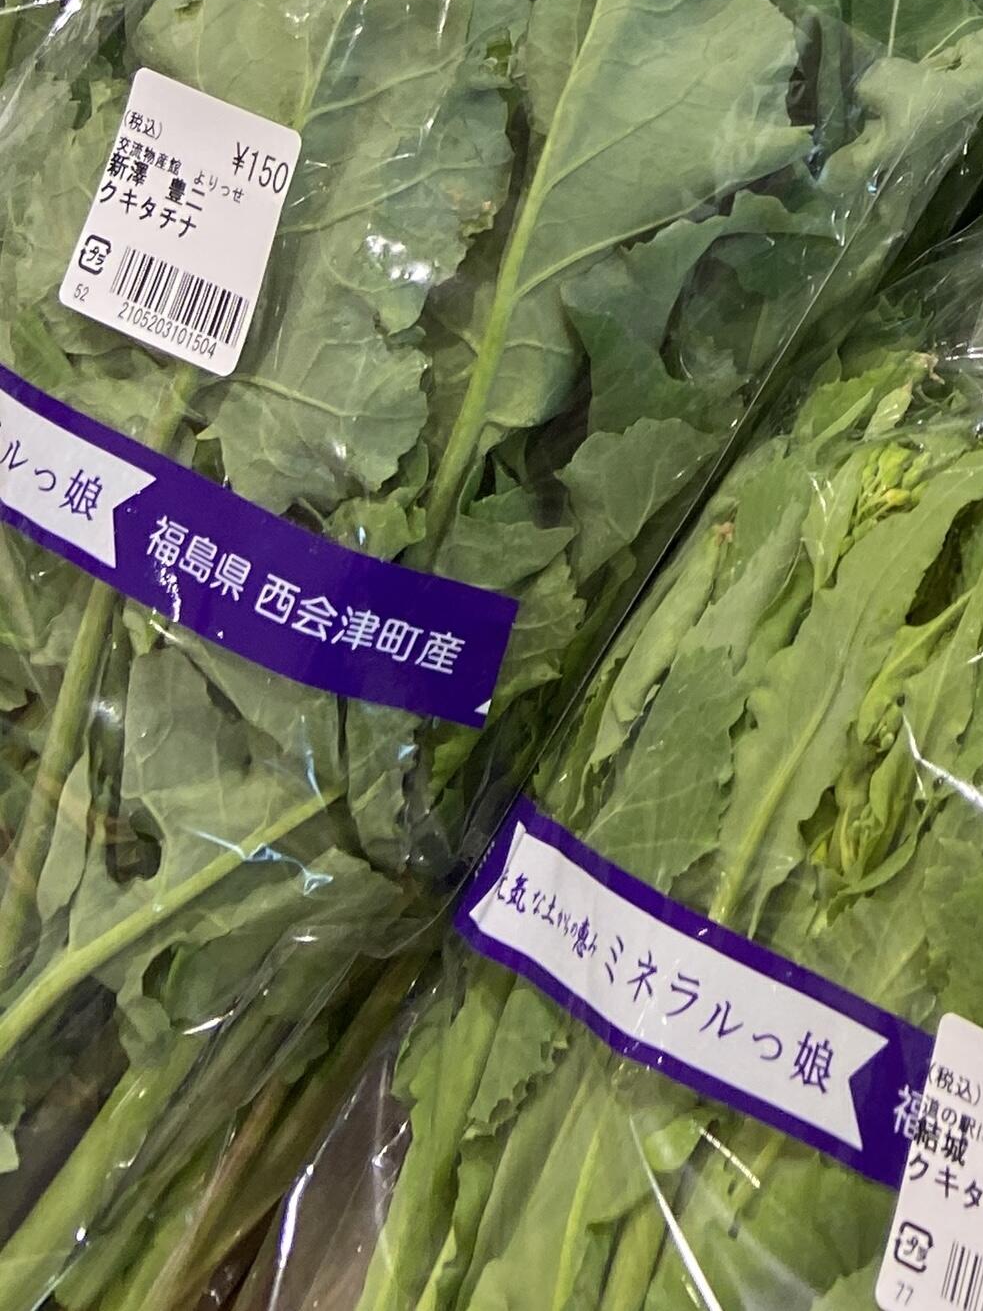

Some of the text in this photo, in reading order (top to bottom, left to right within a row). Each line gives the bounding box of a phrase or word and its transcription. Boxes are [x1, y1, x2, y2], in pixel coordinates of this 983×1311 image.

[106, 152, 206, 212] 新澤 豊二
[116, 136, 245, 204] 交流物産館 よりっせ
[124, 109, 290, 195] (税込) ¥150
[99, 180, 197, 239] クキタチナ
[73, 282, 90, 302] 52
[117, 301, 218, 360] 2105203101504
[0, 439, 467, 676] ルっ娘 福島県 西会津町産
[604, 934, 834, 1094] ミネラルっ娘
[927, 1062, 982, 1107] (税込)
